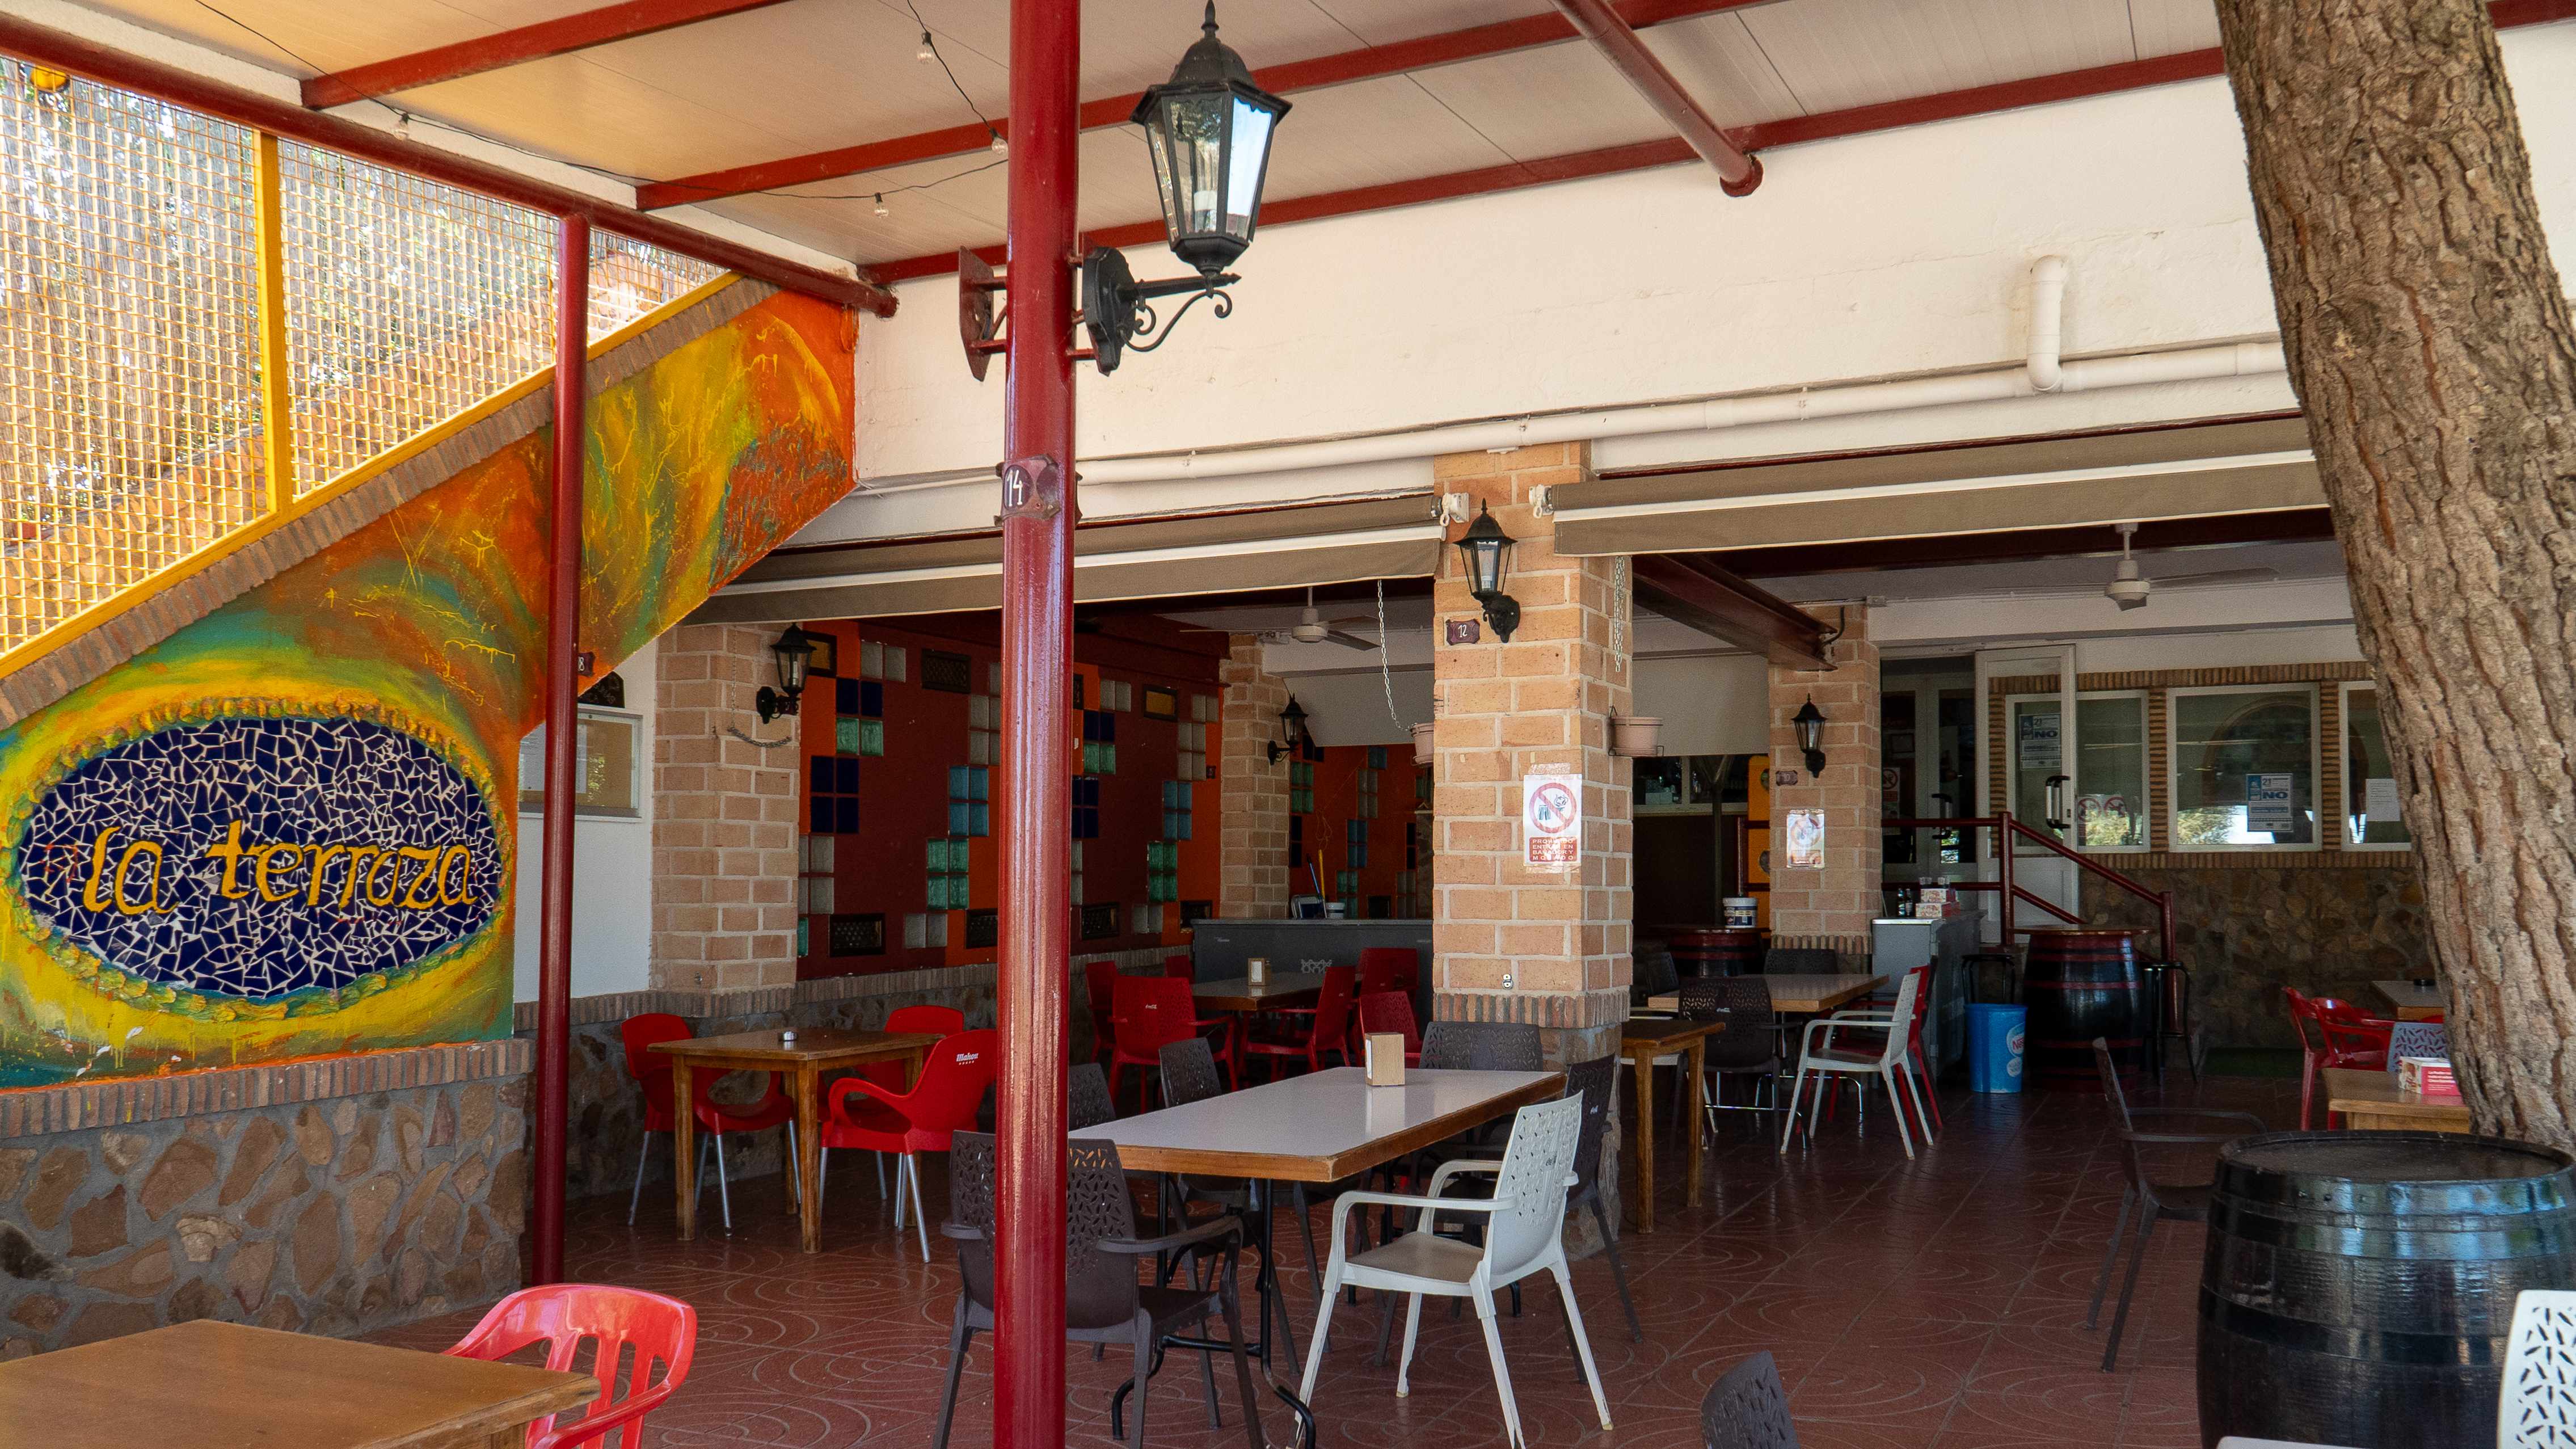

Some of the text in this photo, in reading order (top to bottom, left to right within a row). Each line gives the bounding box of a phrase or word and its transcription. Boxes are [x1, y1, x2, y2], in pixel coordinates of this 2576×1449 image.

[1007, 470, 1023, 507] 14
[1458, 624, 1468, 638] 12
[83, 820, 478, 915] la terraza
